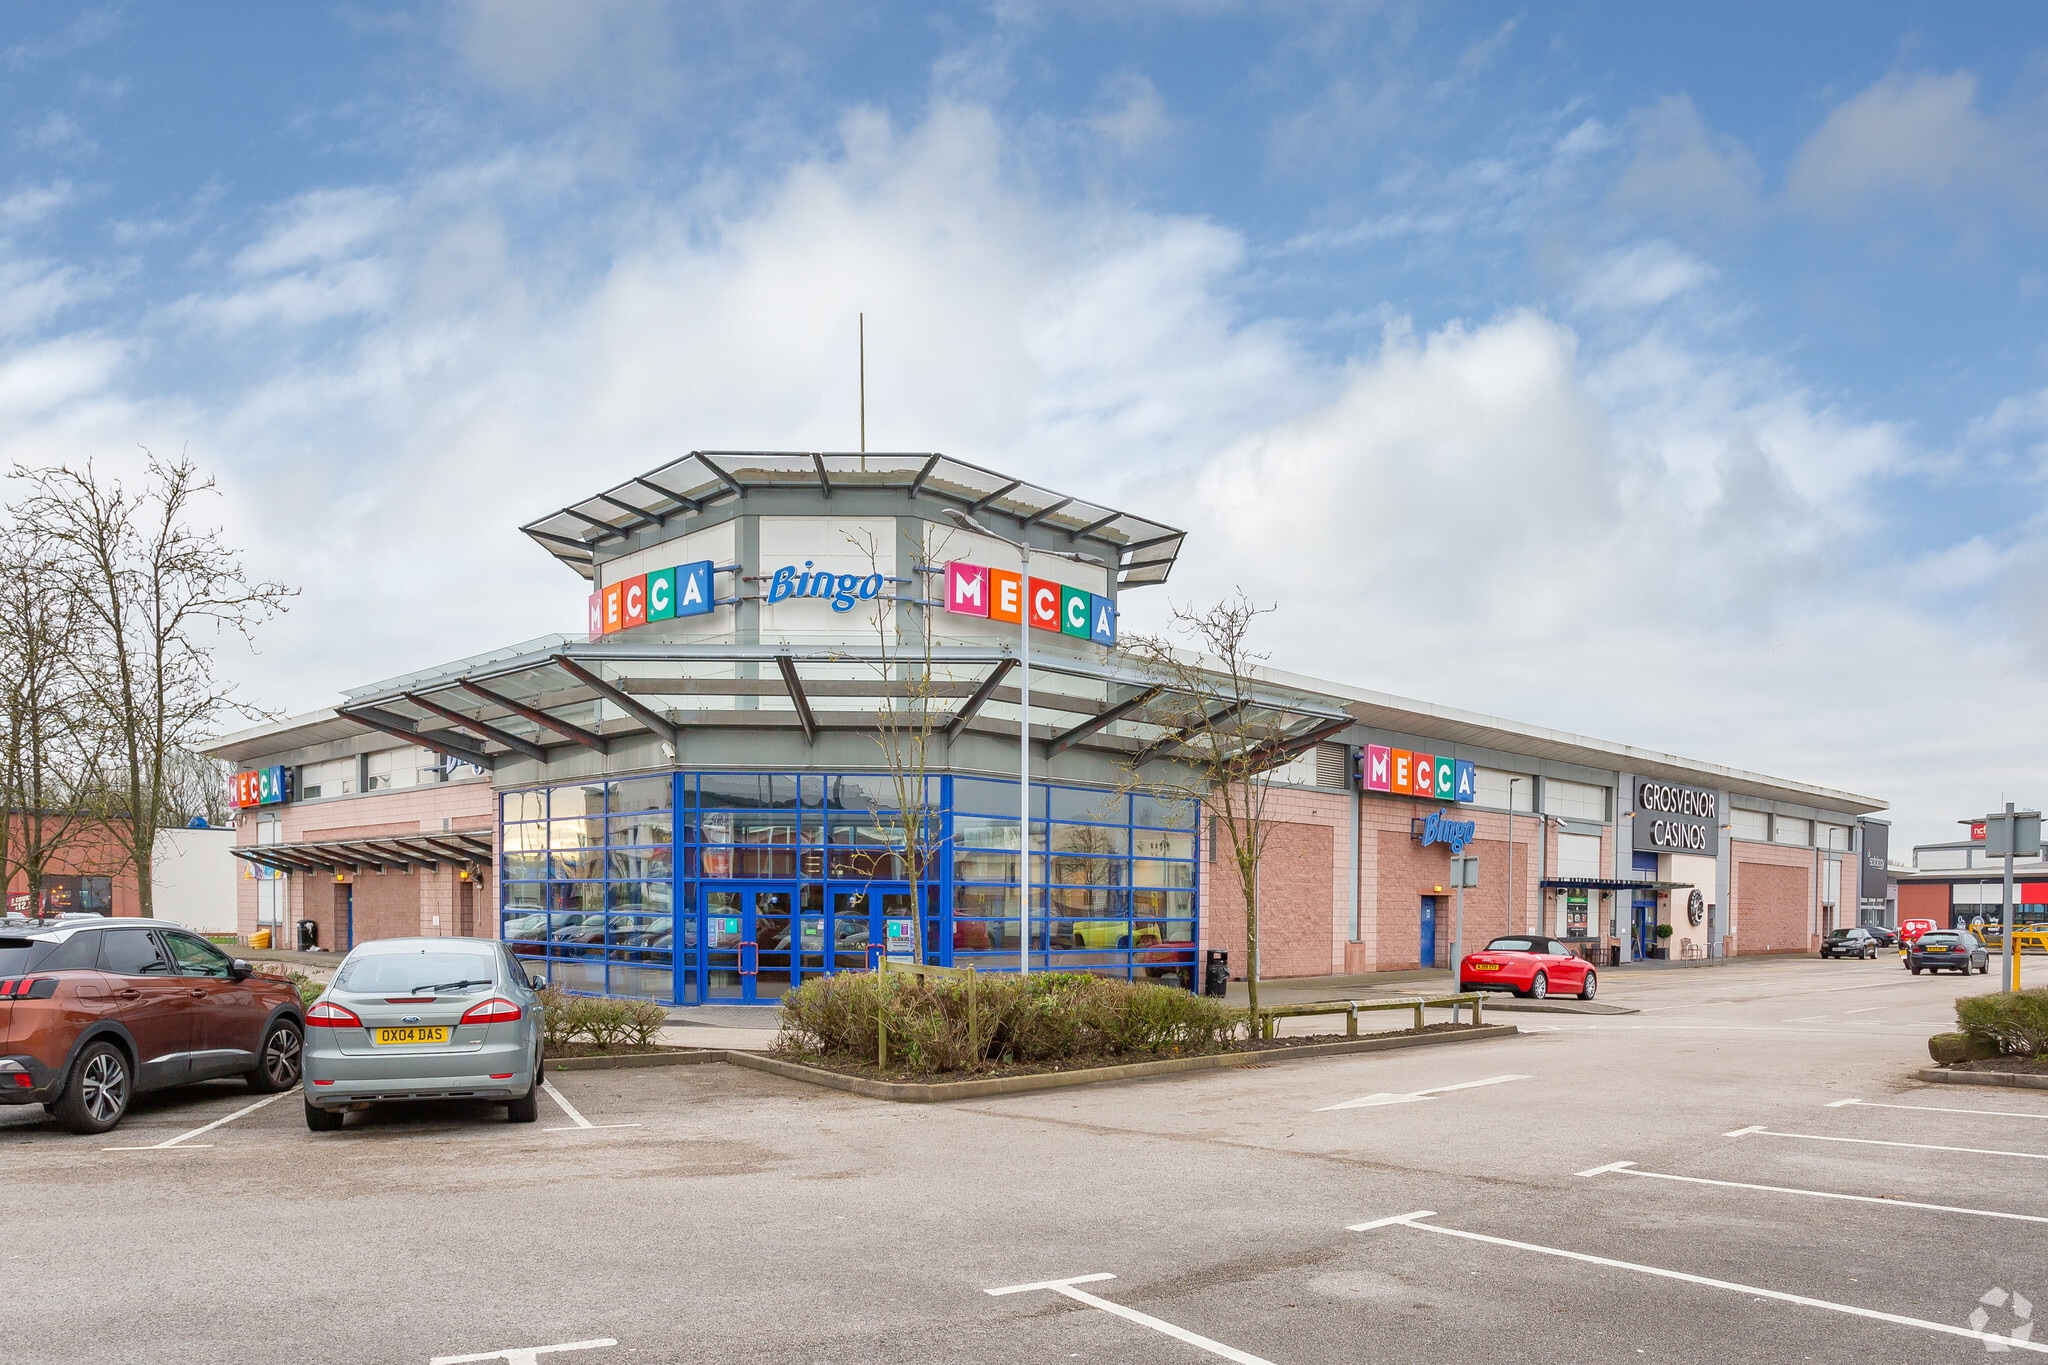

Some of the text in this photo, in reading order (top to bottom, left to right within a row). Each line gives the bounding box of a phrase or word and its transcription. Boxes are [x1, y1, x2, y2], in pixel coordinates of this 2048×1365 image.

[591, 572, 703, 632] MECCA
[767, 560, 884, 613] Bingo
[955, 571, 1111, 637] MECCA
[230, 772, 280, 803] MECCA
[1371, 753, 1471, 795] MECCA
[1643, 783, 1716, 818] GROSVENOR
[1422, 807, 1476, 854] Bingo
[1654, 819, 1706, 850] CASINOS
[382, 1028, 442, 1042] OX04 DAS
